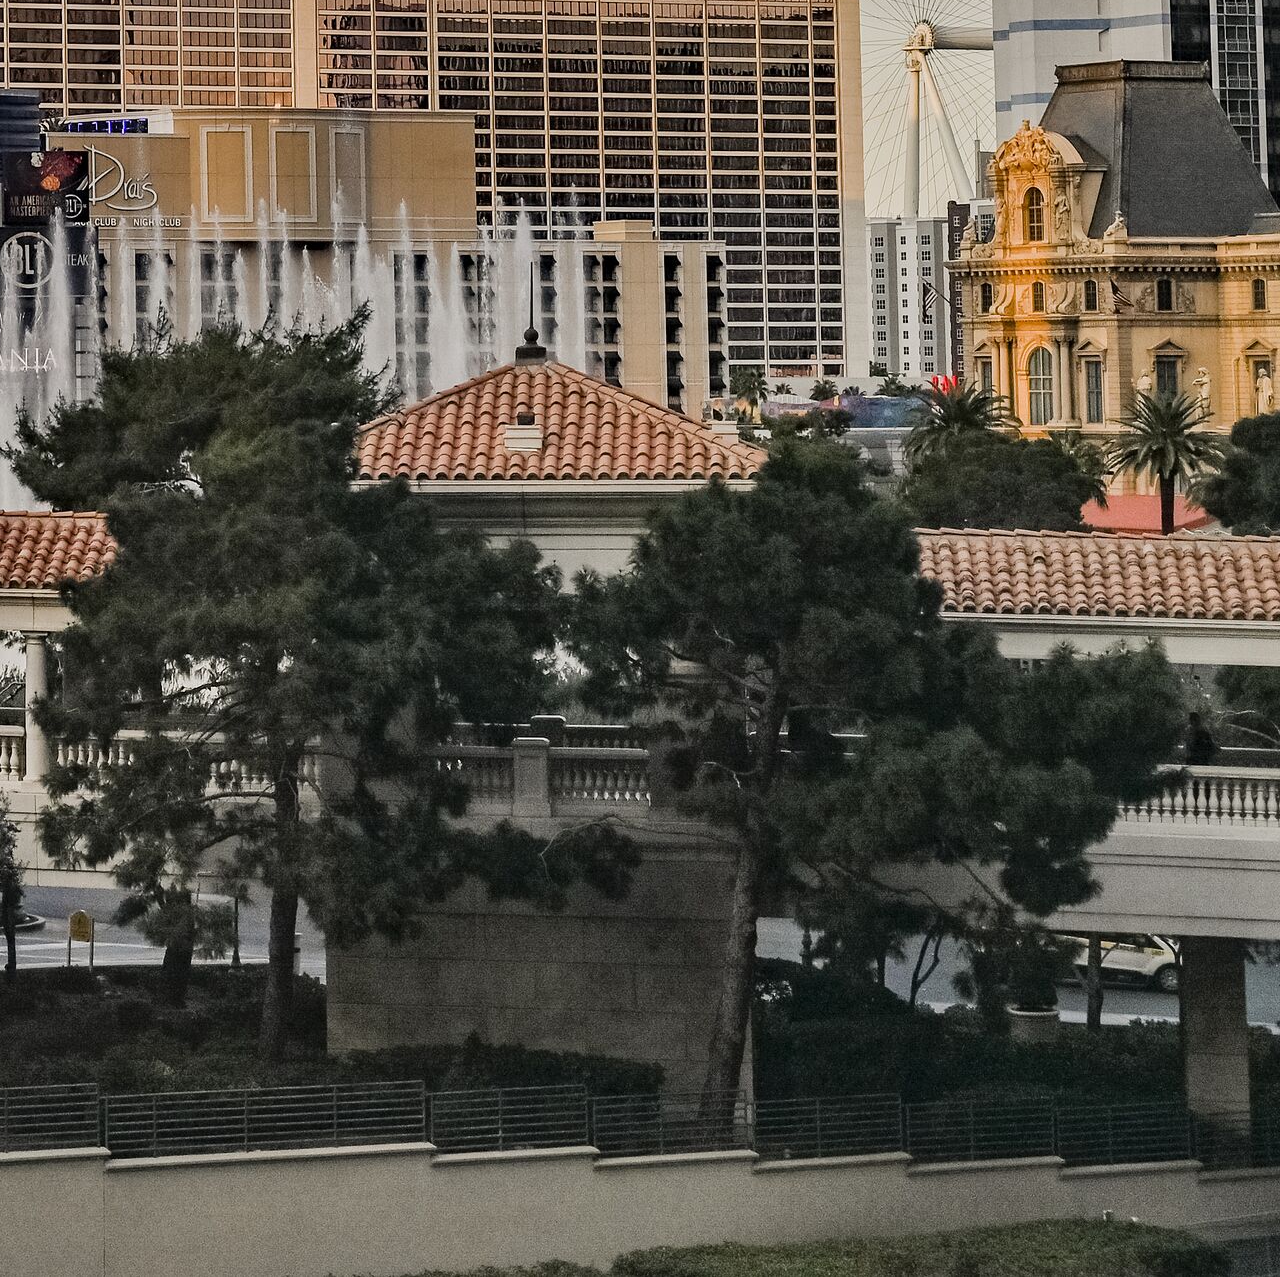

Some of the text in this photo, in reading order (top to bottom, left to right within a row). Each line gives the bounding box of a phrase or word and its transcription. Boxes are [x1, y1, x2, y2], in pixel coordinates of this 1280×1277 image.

[94, 218, 117, 227] CLUB
[133, 218, 181, 227] NIGH CLUB
[64, 254, 89, 266] TEAK
